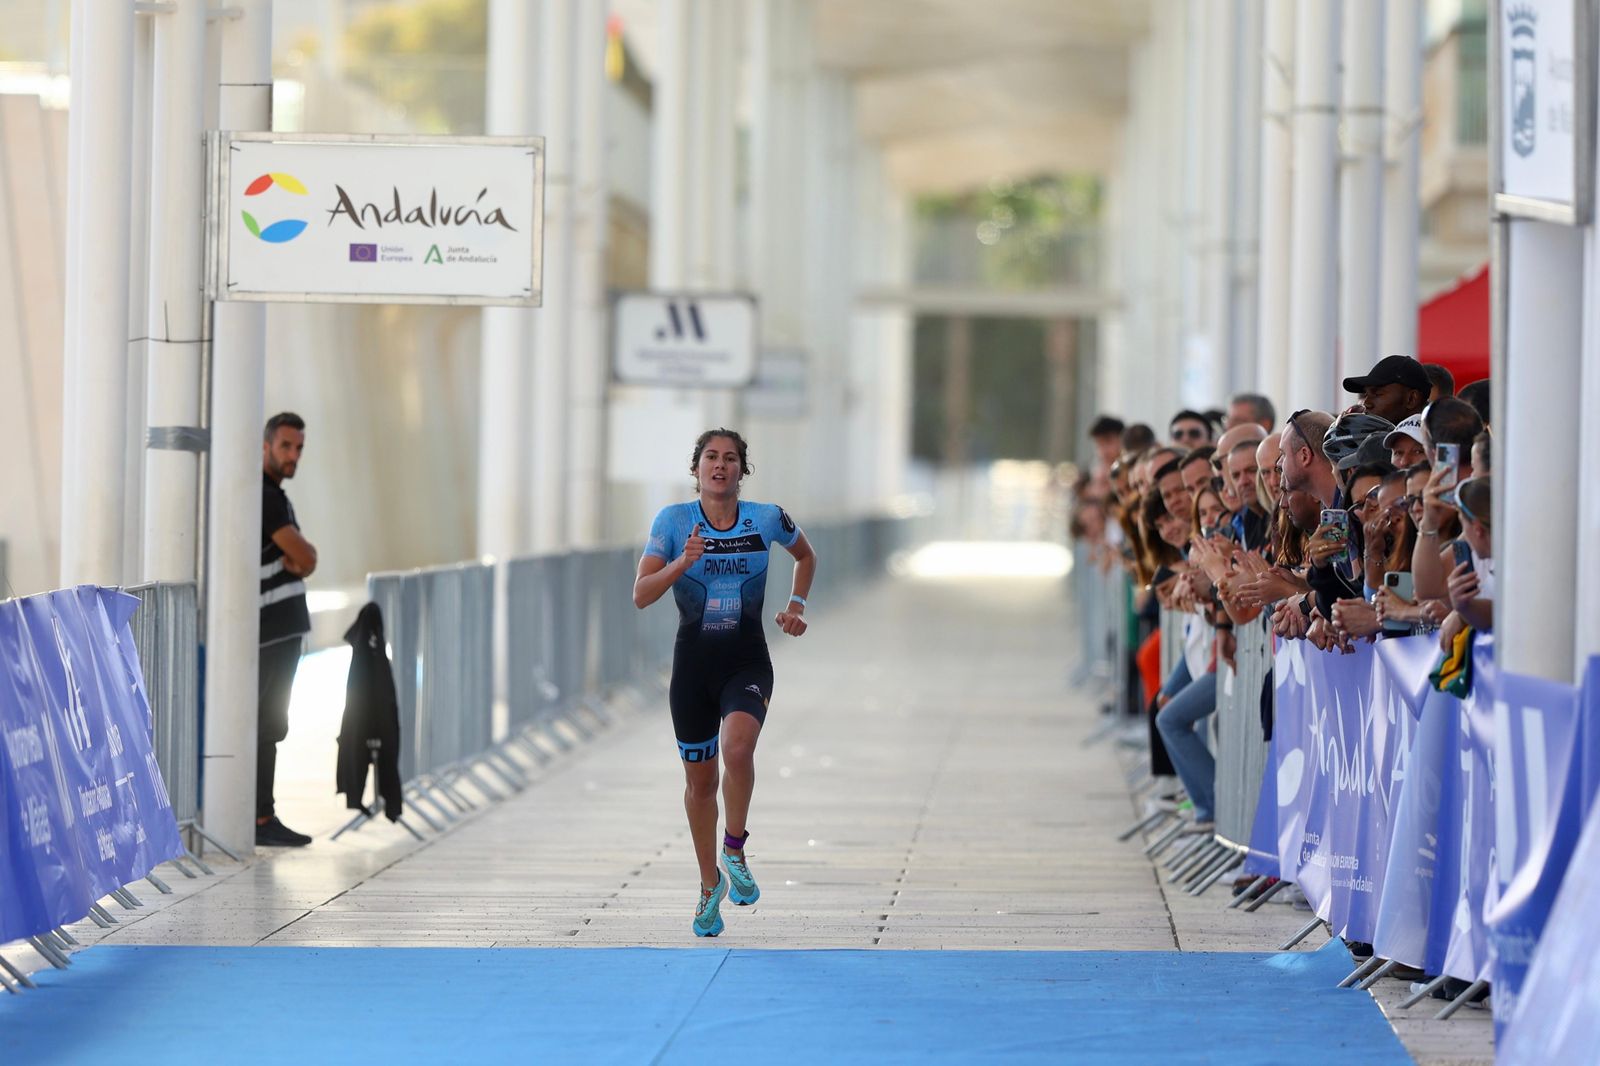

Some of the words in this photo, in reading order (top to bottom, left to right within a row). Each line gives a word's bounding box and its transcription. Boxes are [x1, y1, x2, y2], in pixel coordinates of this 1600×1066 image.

[326, 183, 519, 232] Andalucía
[447, 246, 470, 254] Junta
[380, 254, 413, 264] Europea
[446, 255, 456, 263] de
[703, 557, 751, 577] PINTANEL
